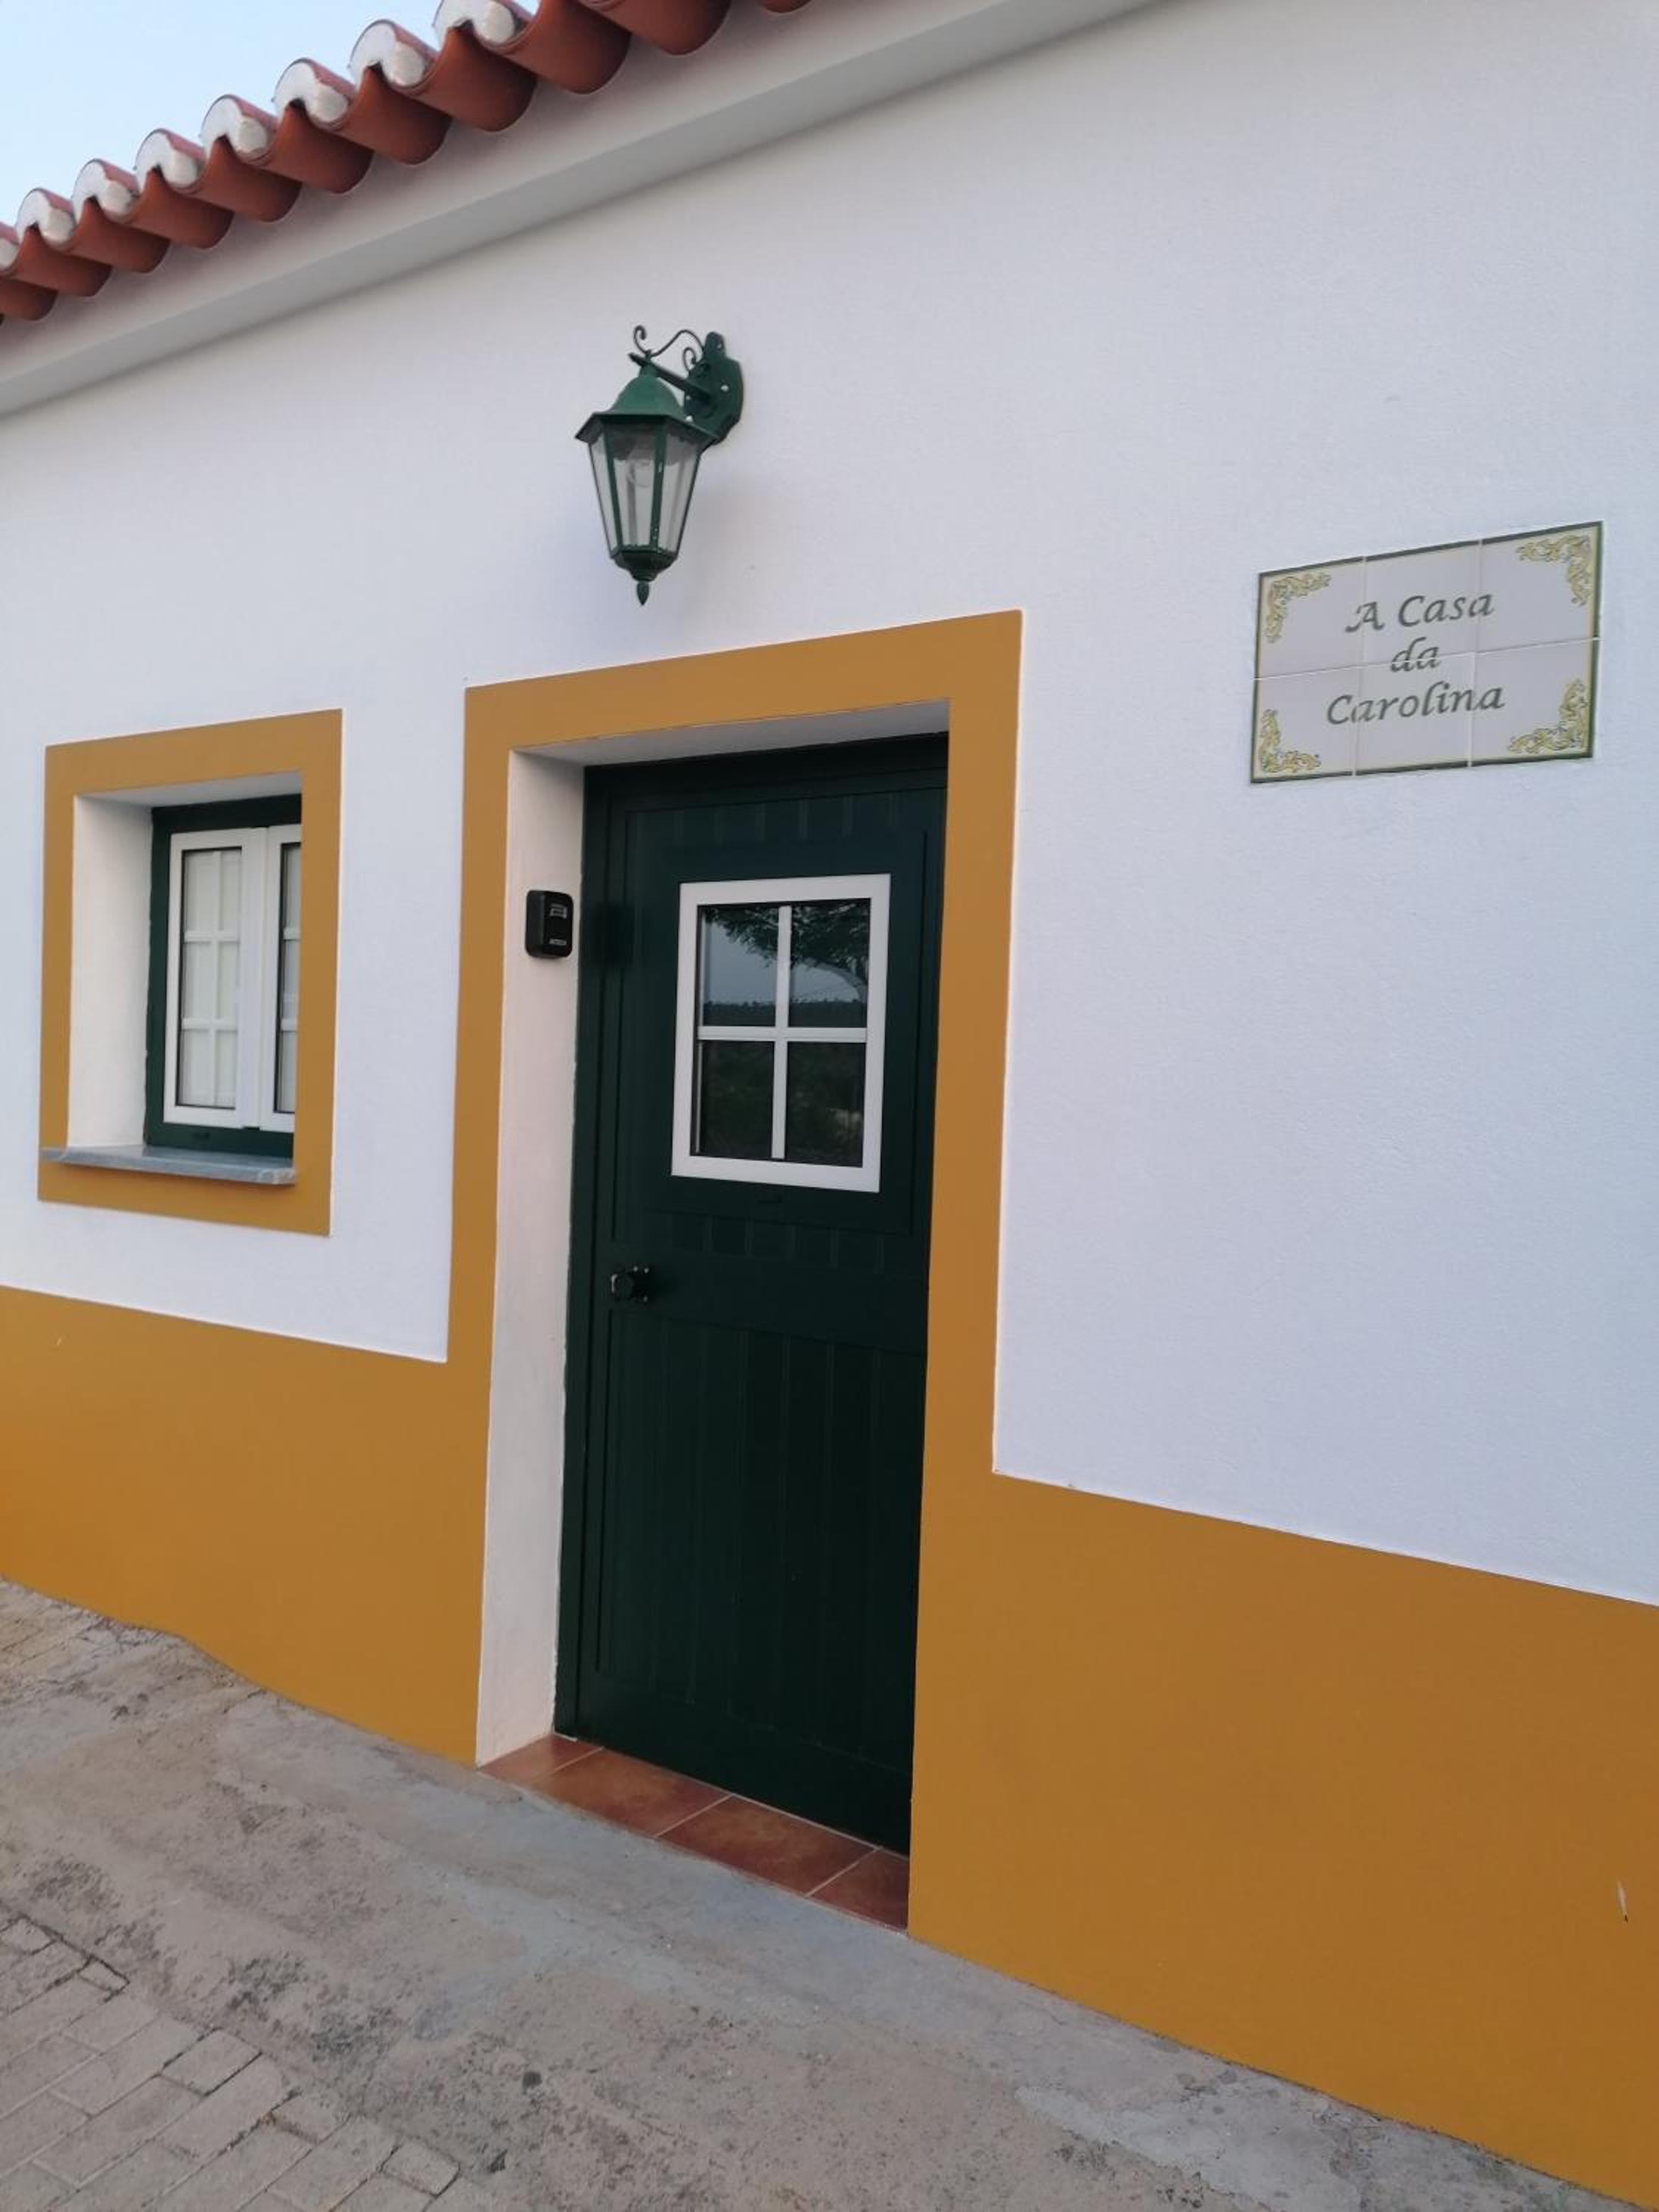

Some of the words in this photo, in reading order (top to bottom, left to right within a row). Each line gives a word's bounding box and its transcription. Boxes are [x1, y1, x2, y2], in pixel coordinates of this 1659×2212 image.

[1345, 601, 1385, 633] A
[1398, 594, 1495, 627] Casa
[1390, 636, 1441, 672] da
[1326, 681, 1506, 725] Carolina
